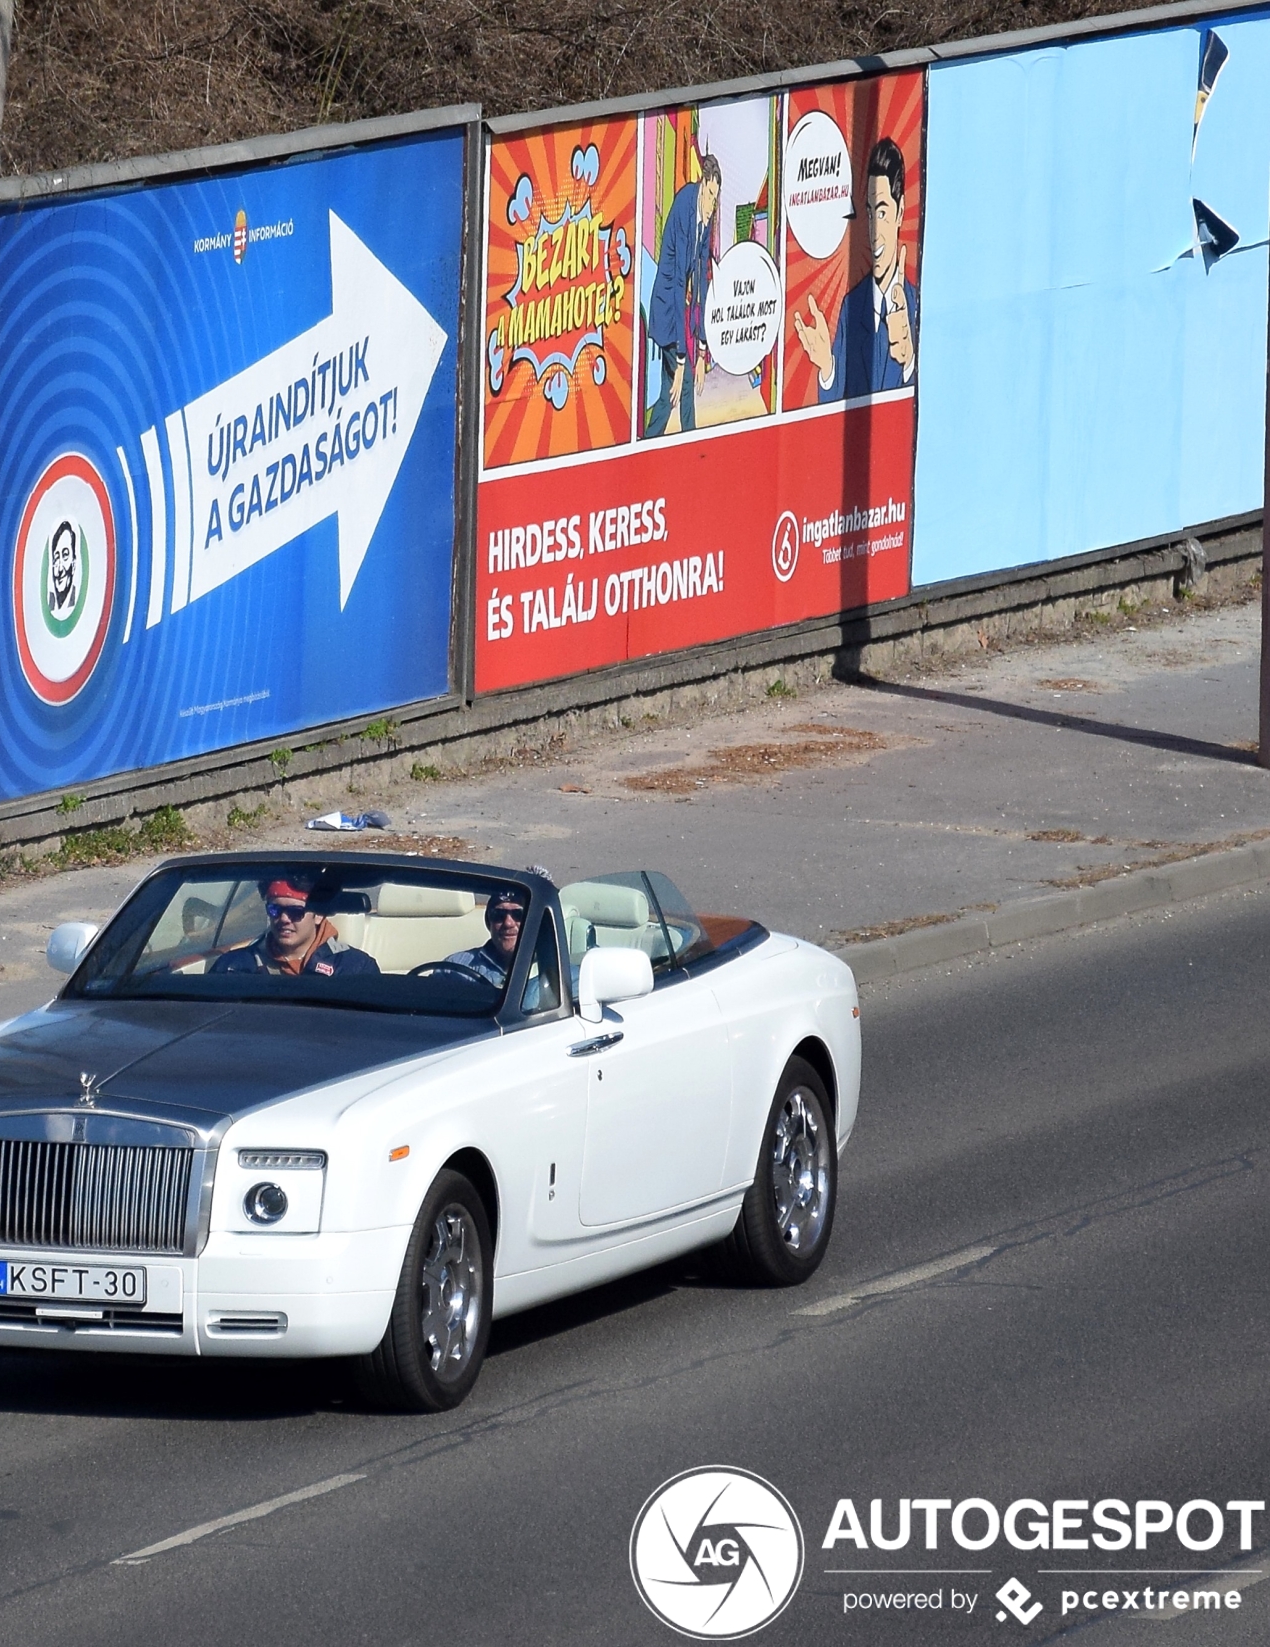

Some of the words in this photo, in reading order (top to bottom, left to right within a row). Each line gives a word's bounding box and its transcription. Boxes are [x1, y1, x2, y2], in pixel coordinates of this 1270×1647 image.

[797, 151, 841, 182] MEGVAN!
[789, 184, 850, 207] INGATLANBAZAR.HU
[194, 231, 232, 253] KORMÁNY
[248, 217, 294, 243] INFORMÁCIÓ
[521, 205, 604, 294] BEZÁRT
[733, 279, 756, 298] VAJON
[496, 315, 506, 347] A
[508, 275, 625, 348] MAMAHOTEL?
[711, 307, 724, 324] HOL
[726, 298, 756, 321] TALÁLOK
[757, 299, 777, 318] MOST
[721, 329, 734, 346] EGY
[735, 320, 767, 344] LAKÁST?
[207, 334, 370, 483] ÚJRAINDÍTJUK
[204, 497, 223, 550] A
[228, 385, 398, 533] GAZDASÁGOT!
[488, 515, 584, 574] HIRDESS,
[588, 497, 669, 555] KERESS,
[802, 497, 906, 548] ingatlanbazar.hu
[487, 587, 514, 641] ÉS
[520, 572, 598, 634] TALÁLJ
[603, 550, 724, 616] OTTHONRA!
[10, 1266, 137, 1297] KSFT-30
